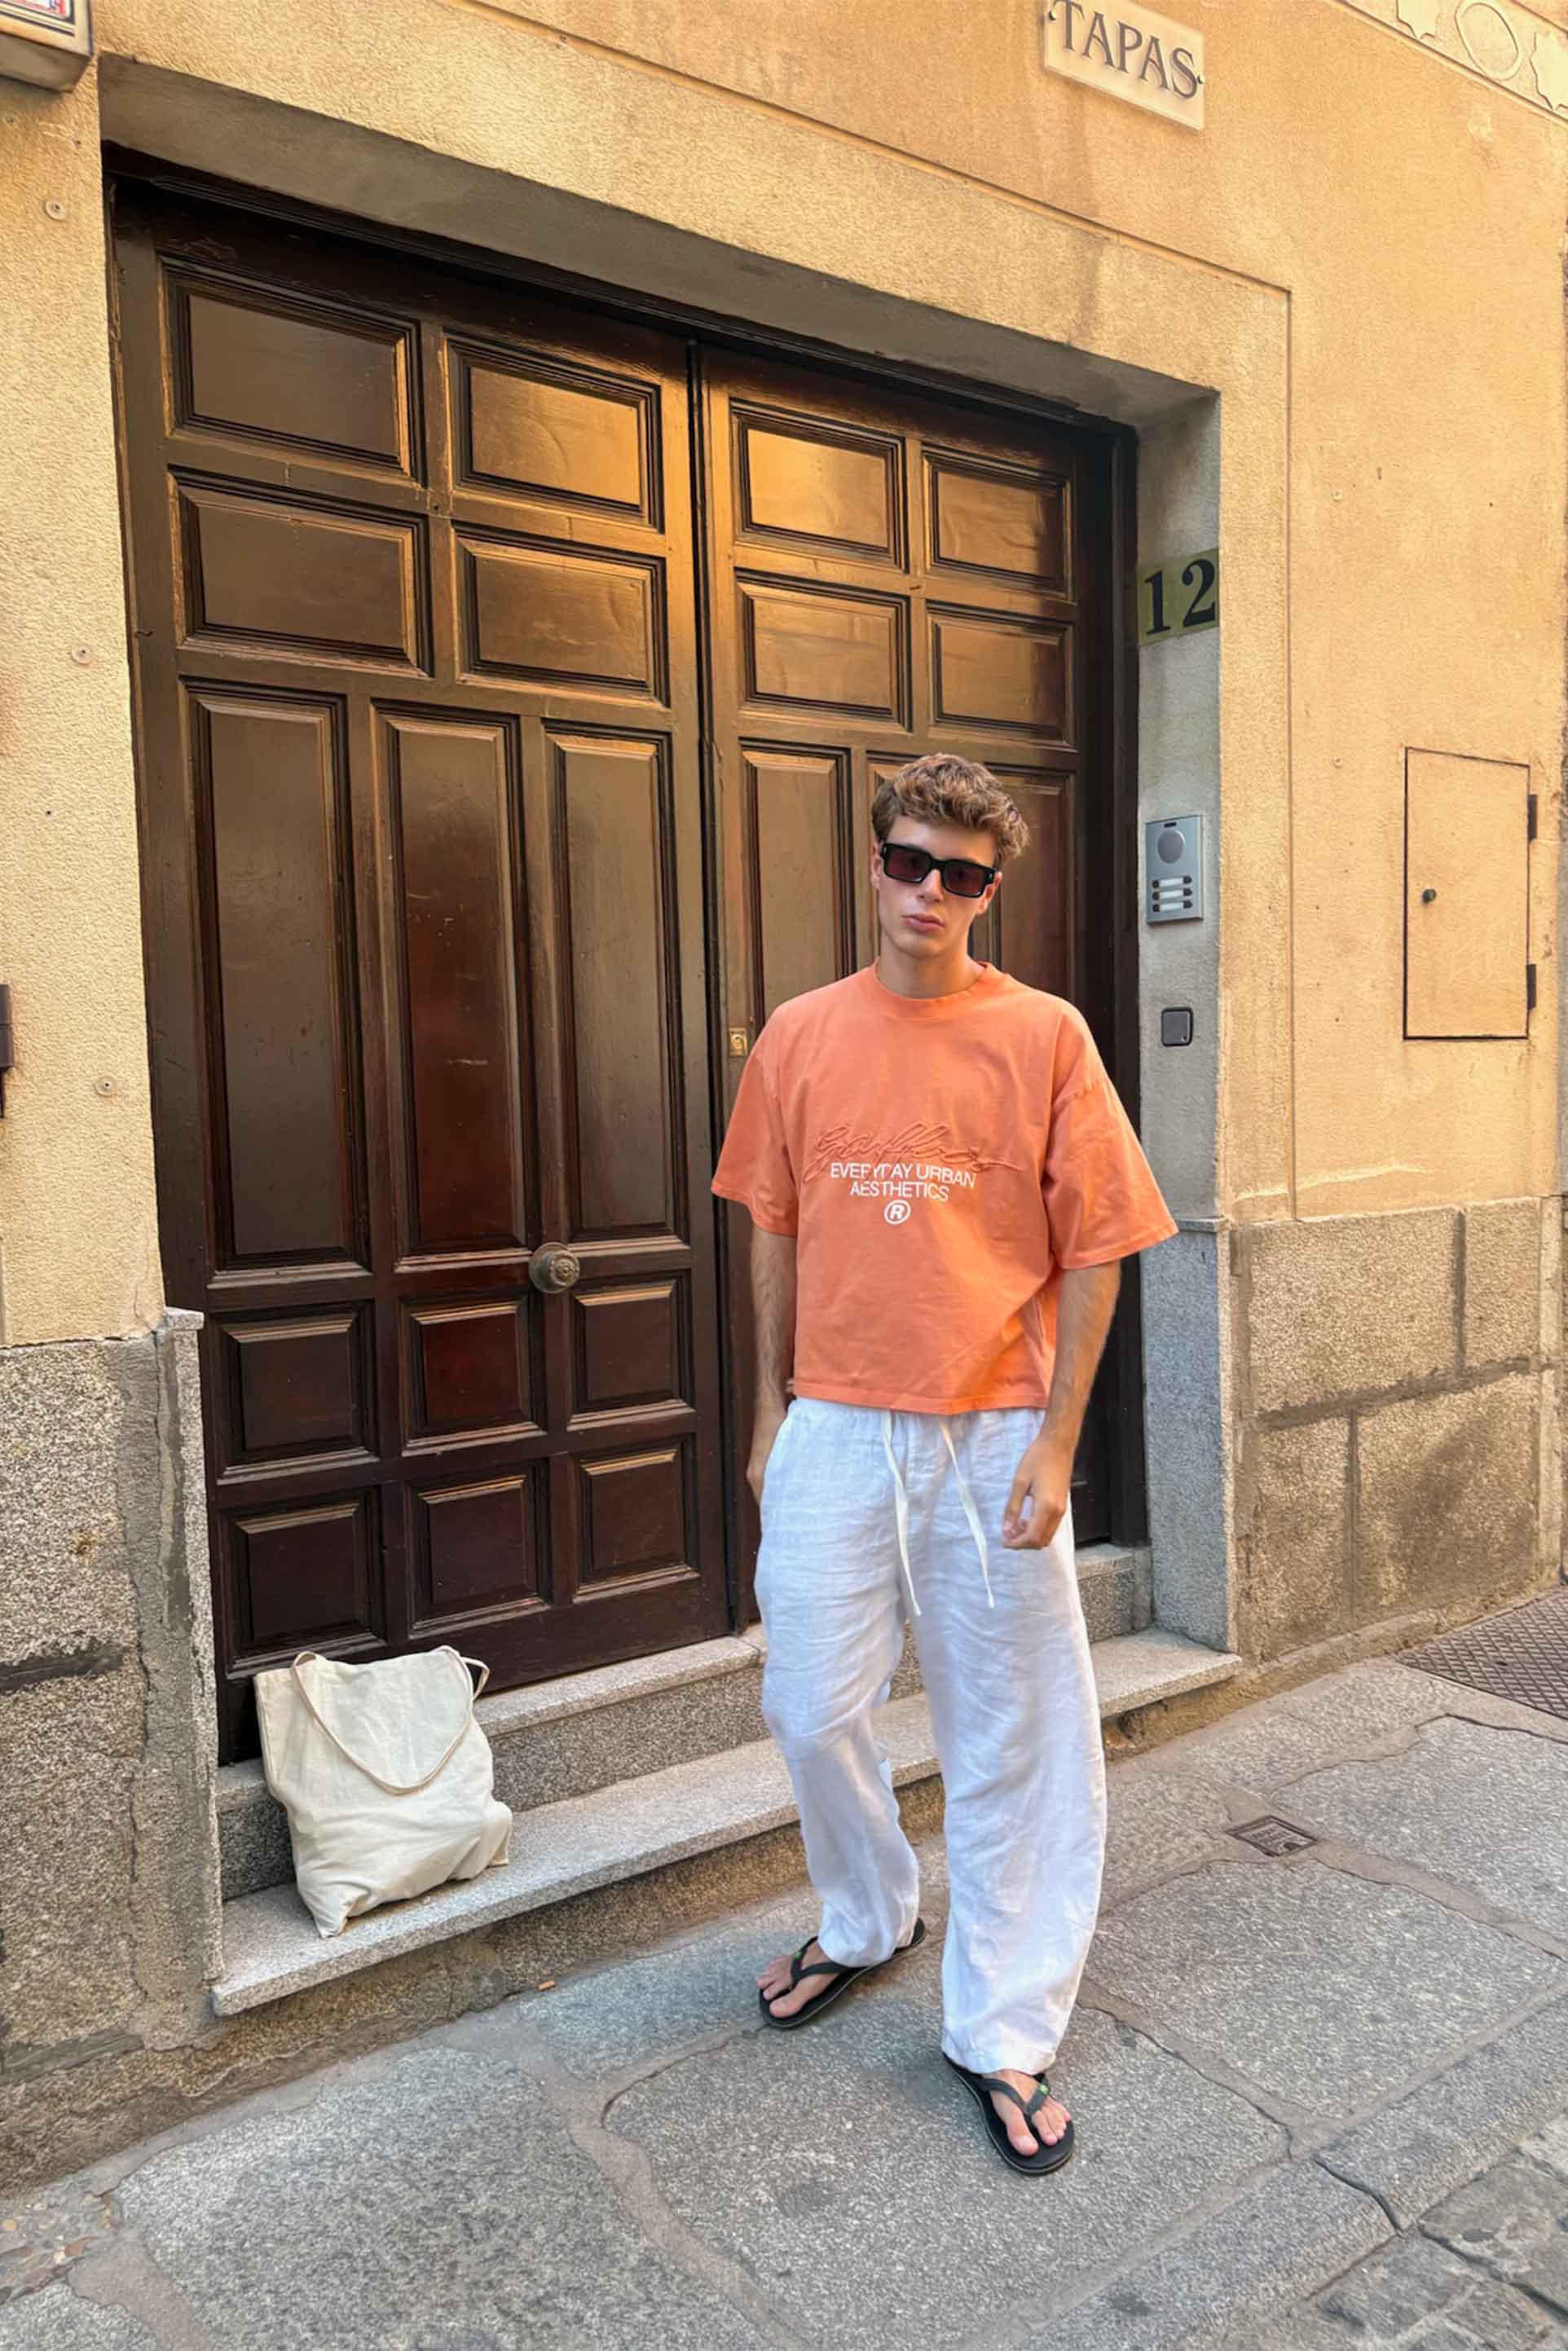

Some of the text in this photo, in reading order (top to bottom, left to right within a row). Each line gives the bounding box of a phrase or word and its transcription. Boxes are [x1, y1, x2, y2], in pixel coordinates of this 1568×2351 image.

[1054, 0, 1198, 99] TAPAS
[1144, 559, 1216, 636] 12
[849, 1180, 949, 1202] AESTHETICS
[915, 1163, 977, 1188] URBAN
